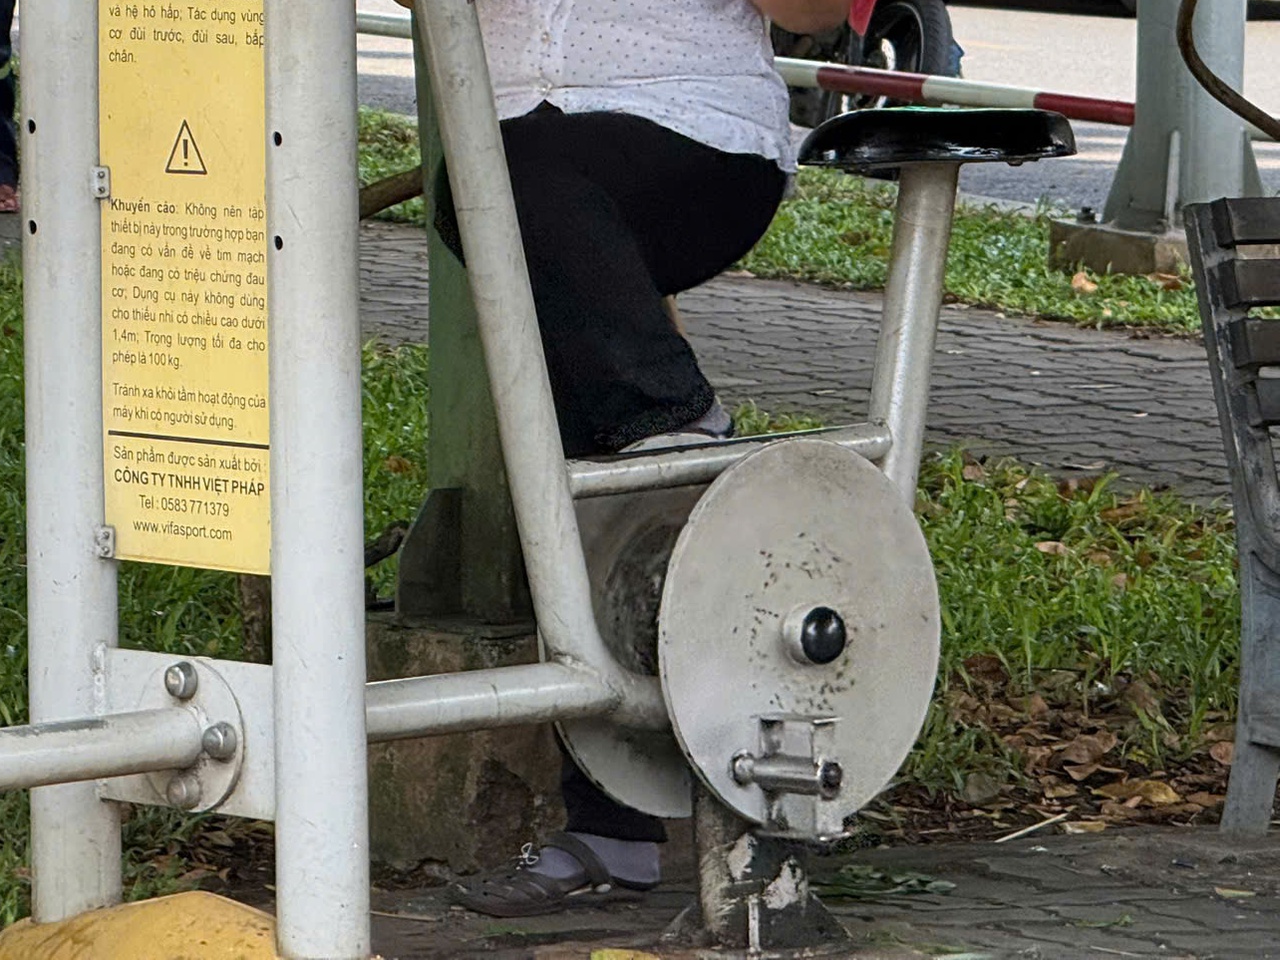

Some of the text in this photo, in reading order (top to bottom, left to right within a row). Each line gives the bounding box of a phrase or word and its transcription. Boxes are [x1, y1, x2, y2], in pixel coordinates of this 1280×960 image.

[126, 5, 138, 19] hệ
[188, 7, 206, 20] Tác
[211, 8, 235, 25] dụng
[109, 29, 122, 39] cơ
[216, 33, 237, 45] sau,
[109, 49, 136, 63] chân.
[111, 197, 150, 214] Khuyến
[186, 202, 217, 219] Không
[224, 208, 242, 217] nên
[163, 224, 187, 240] trong
[225, 228, 244, 243] hợp
[246, 228, 264, 242] bạn
[111, 242, 135, 259] đang
[238, 252, 264, 265] mạch
[140, 265, 163, 281] đang
[246, 272, 264, 284] đau
[133, 286, 158, 302] Dụng
[164, 292, 175, 304] cụ
[205, 292, 234, 308] không
[112, 308, 129, 320] cho
[221, 317, 238, 327] cao
[242, 316, 265, 329] dưới
[145, 331, 172, 348] Trọng
[178, 333, 207, 350] lượng
[229, 337, 241, 349] đa
[247, 338, 265, 352] cho
[149, 353, 166, 365] 100
[142, 388, 153, 398] xa
[198, 391, 220, 406] hoạt
[222, 392, 246, 410] động
[248, 395, 266, 408] của
[135, 406, 149, 419] khi
[164, 410, 193, 425] người
[168, 451, 195, 467] được
[114, 466, 265, 496] CÔNG TY TNHH VIỆT PHÁP
[161, 498, 188, 513] 0583
[190, 501, 229, 516] 771379
[133, 520, 232, 540] www.vifasport.com
